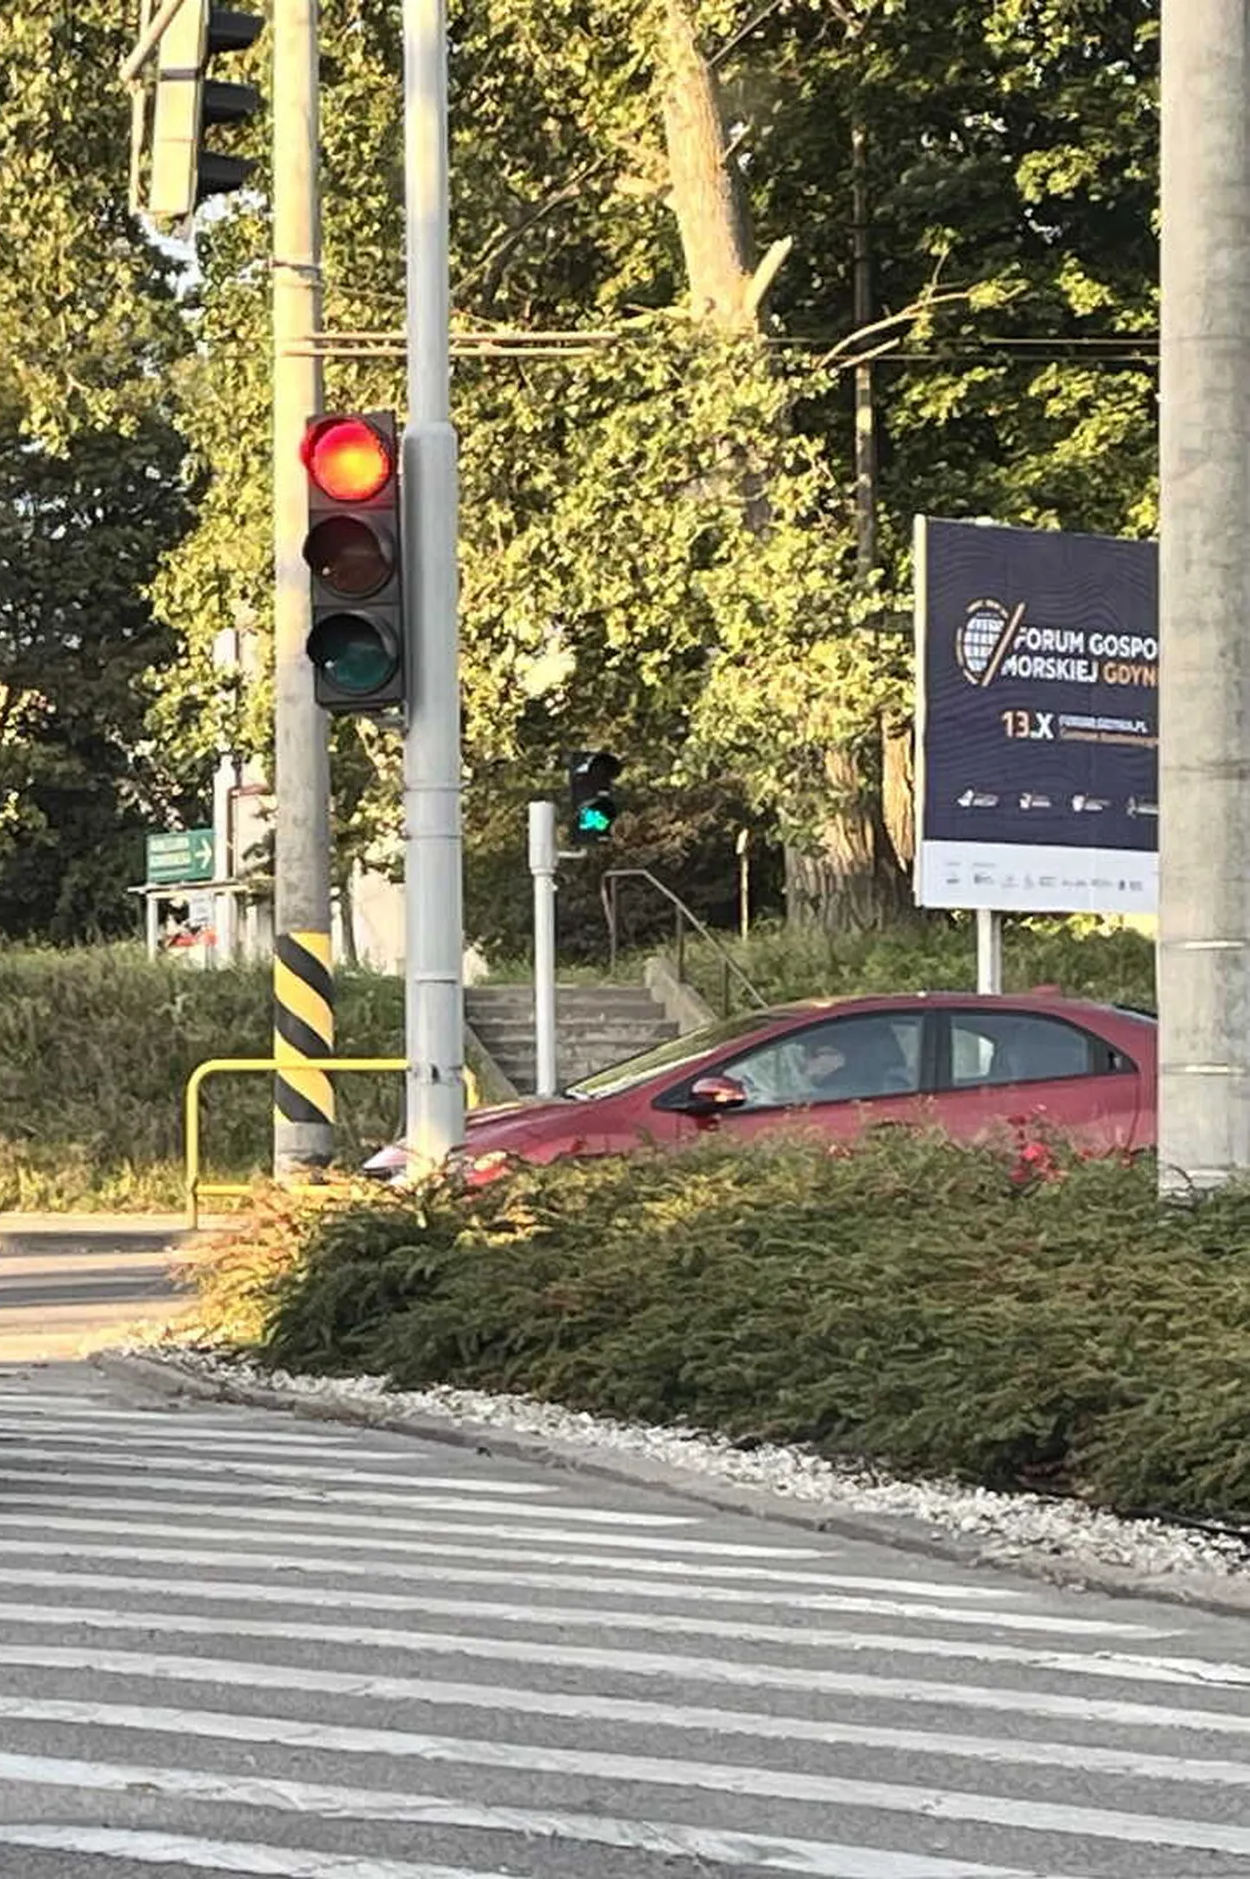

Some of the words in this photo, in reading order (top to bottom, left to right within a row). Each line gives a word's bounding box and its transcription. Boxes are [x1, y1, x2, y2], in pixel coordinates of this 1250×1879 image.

[1013, 626, 1085, 653] FORUM
[1089, 632, 1158, 660] GOSPO
[1000, 654, 1099, 683] MORSKIEJ
[1103, 661, 1159, 687] GDYN
[1001, 710, 1055, 740] 13.X
